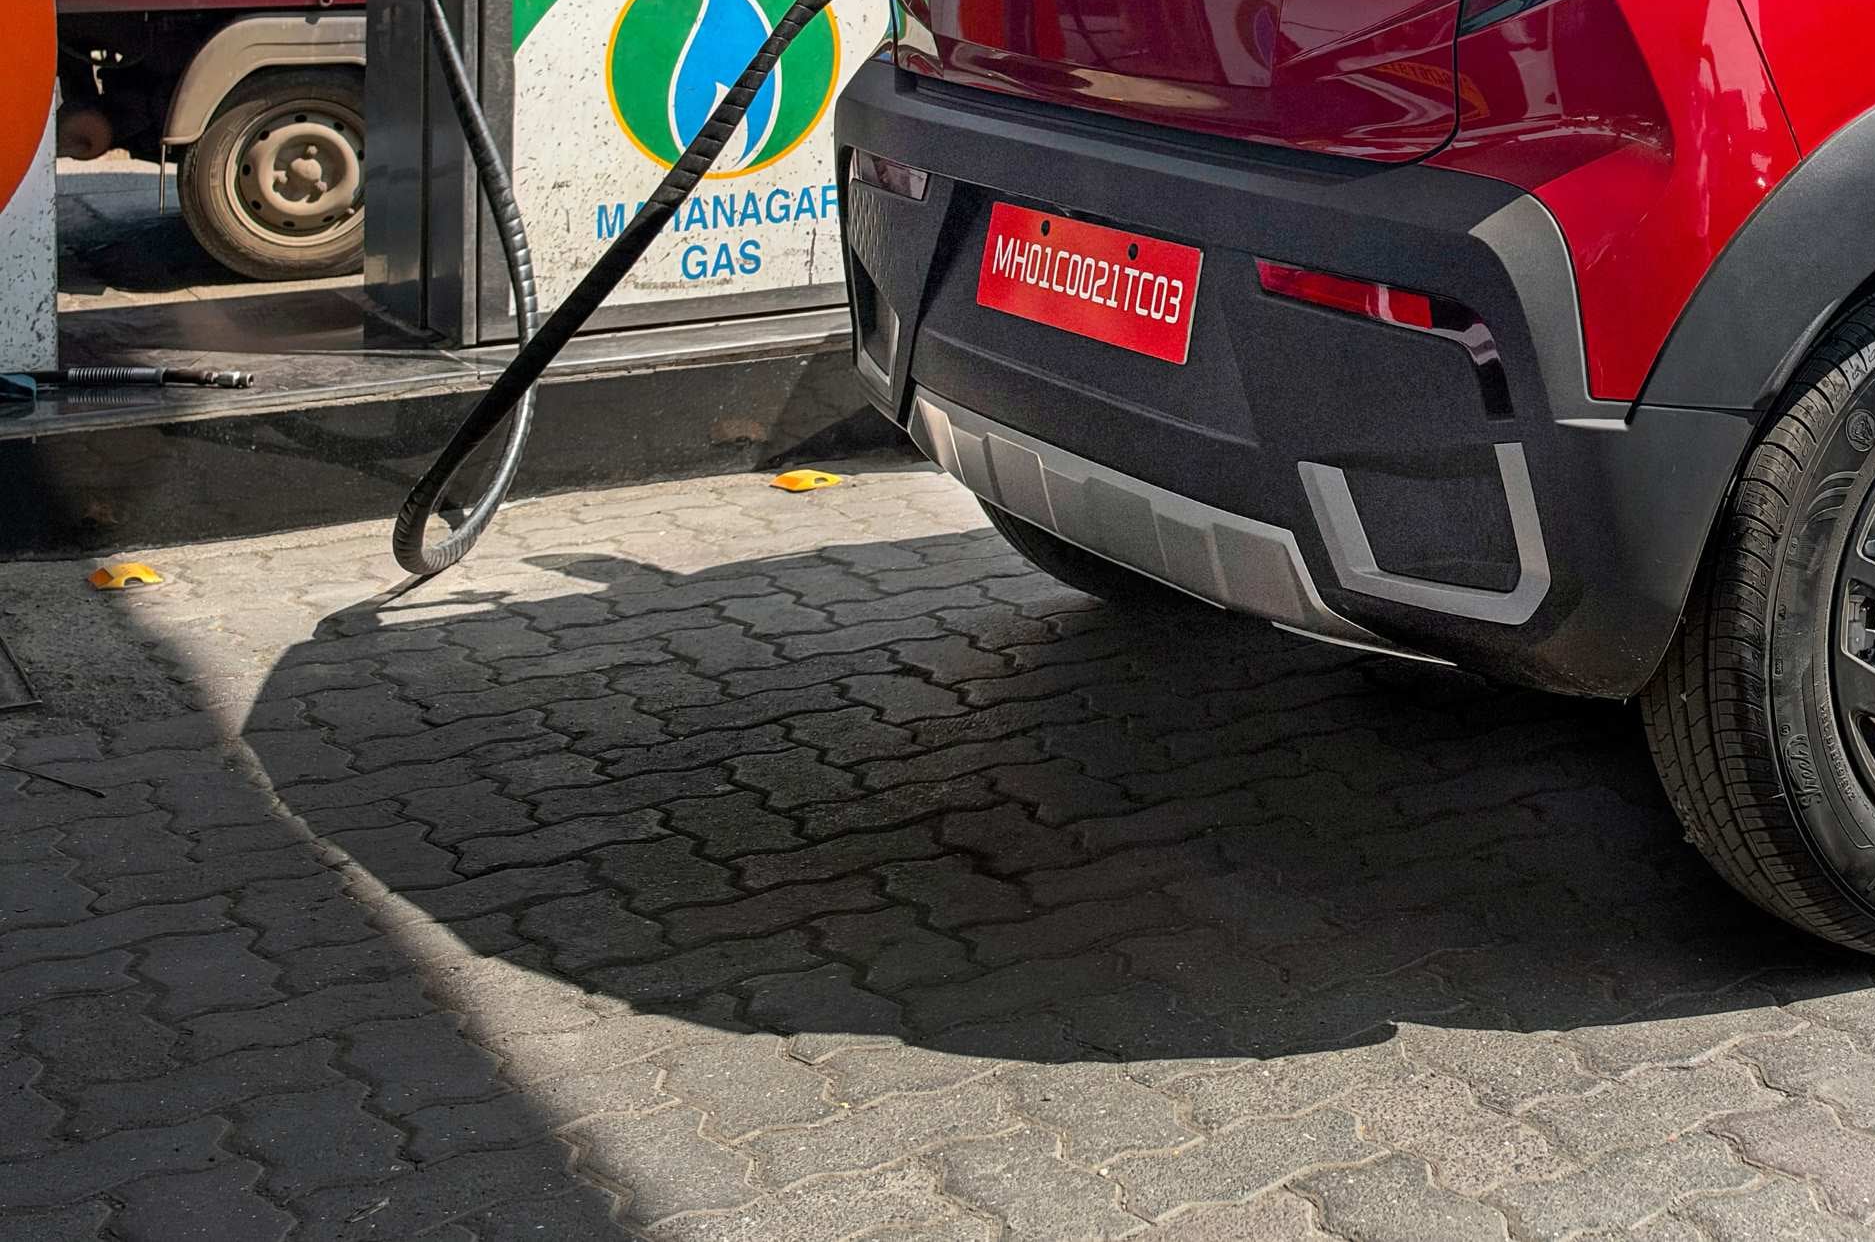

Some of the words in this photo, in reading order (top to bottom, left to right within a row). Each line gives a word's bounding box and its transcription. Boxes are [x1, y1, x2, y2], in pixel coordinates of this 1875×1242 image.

[597, 184, 839, 240] MANAGAR
[681, 239, 762, 281] GAS
[991, 234, 1184, 324] MH01C0021TC03
